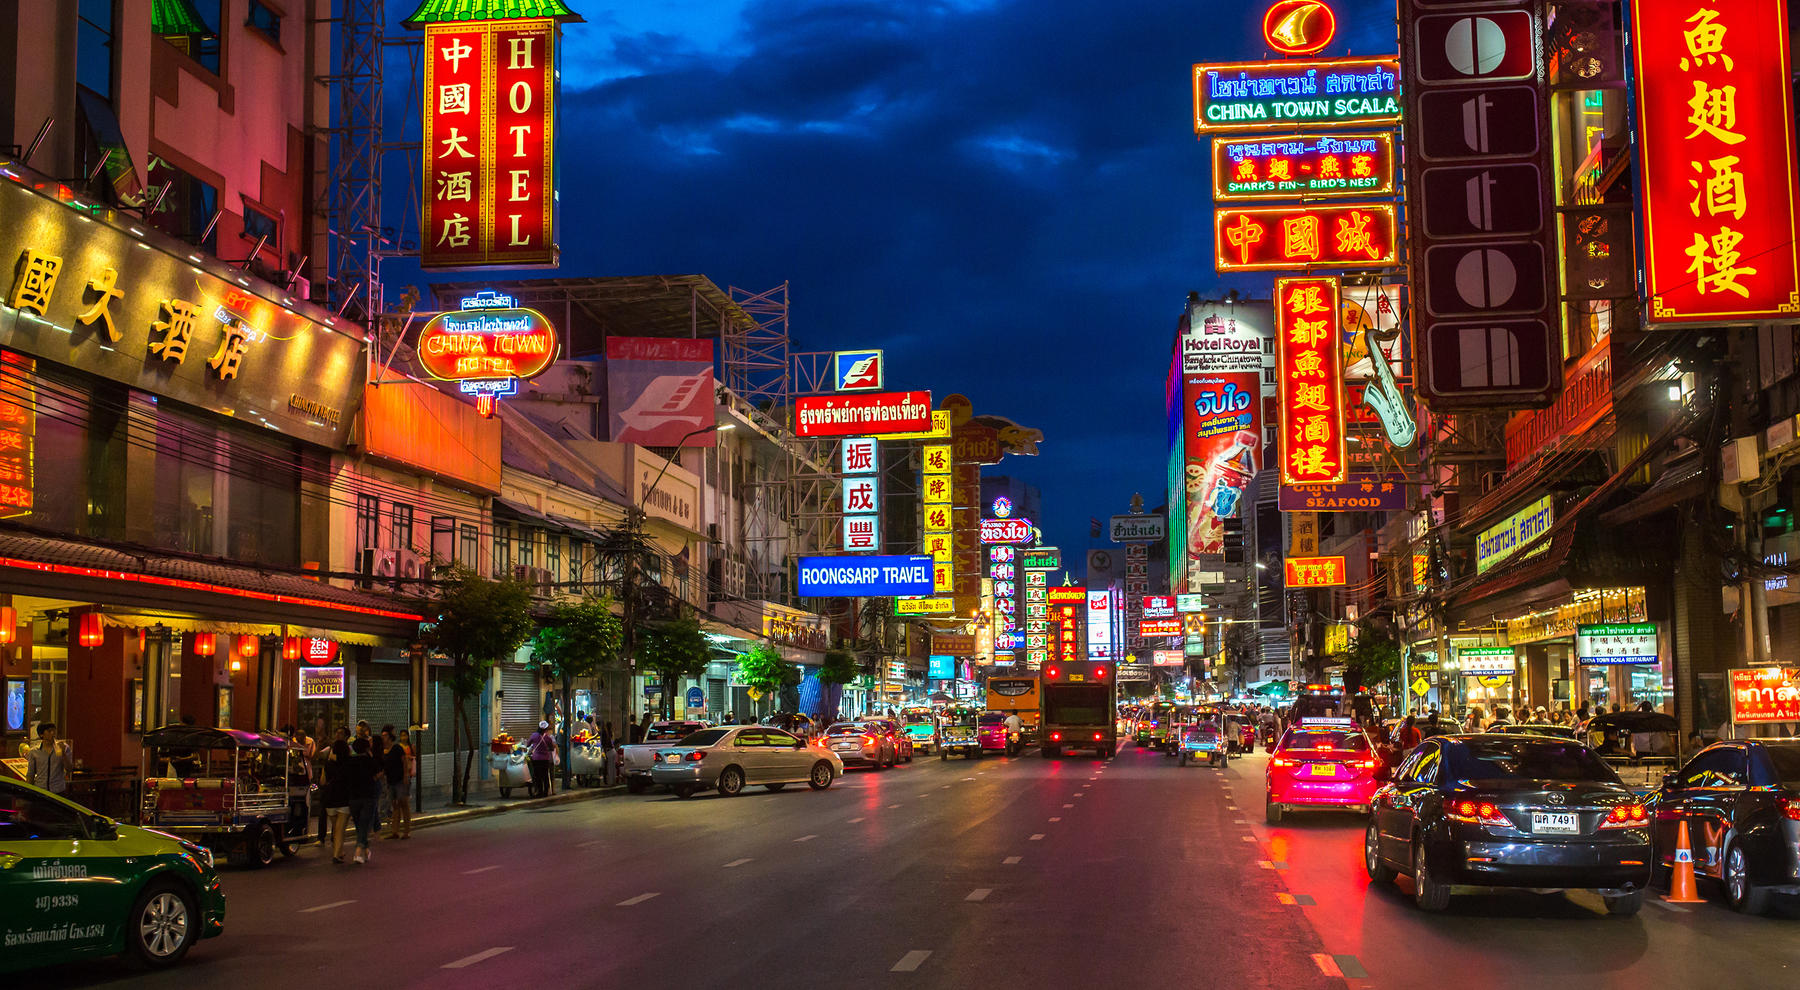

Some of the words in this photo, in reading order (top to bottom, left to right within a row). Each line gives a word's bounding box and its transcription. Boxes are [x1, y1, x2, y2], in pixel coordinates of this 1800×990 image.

[1207, 70, 1317, 98] ไชน่าทาวน์
[1326, 66, 1395, 94] สกาล่า
[1207, 103, 1268, 120] CHINA
[1272, 101, 1329, 118] TOWN
[1334, 98, 1399, 116] SCALA
[436, 38, 476, 248] 中國大酒店
[498, 38, 535, 247] HOTEL
[1228, 181, 1275, 192] SHARK'S
[1279, 181, 1297, 190] FIN
[1310, 178, 1346, 189] BIRD'S
[1350, 177, 1378, 188] NEST
[1226, 211, 1379, 264] 中國城
[427, 335, 485, 354] CHINA
[493, 334, 545, 353] TOWN
[1185, 337, 1221, 351] Hotel
[1223, 336, 1260, 352] Royal
[457, 357, 514, 373] HOTEL
[1286, 286, 1336, 477] 銀都魚翅酒樓
[1195, 383, 1251, 417] จับใจ
[800, 392, 928, 433] รุ่งทรัพย์การท่องเที่ยว
[846, 443, 875, 549] 振成豐
[1306, 497, 1382, 508] SEAFOOD
[980, 522, 1028, 540] ทองใบ
[1520, 500, 1550, 542] สกาล่า
[802, 568, 879, 586] ROONGSARP
[884, 565, 930, 585] TRAVEL
[1092, 599, 1107, 609] SALE
[310, 641, 328, 650] ZEN
[307, 684, 343, 694] HOTEL
[1552, 815, 1575, 825] 7491
[51, 895, 79, 907] 9338
